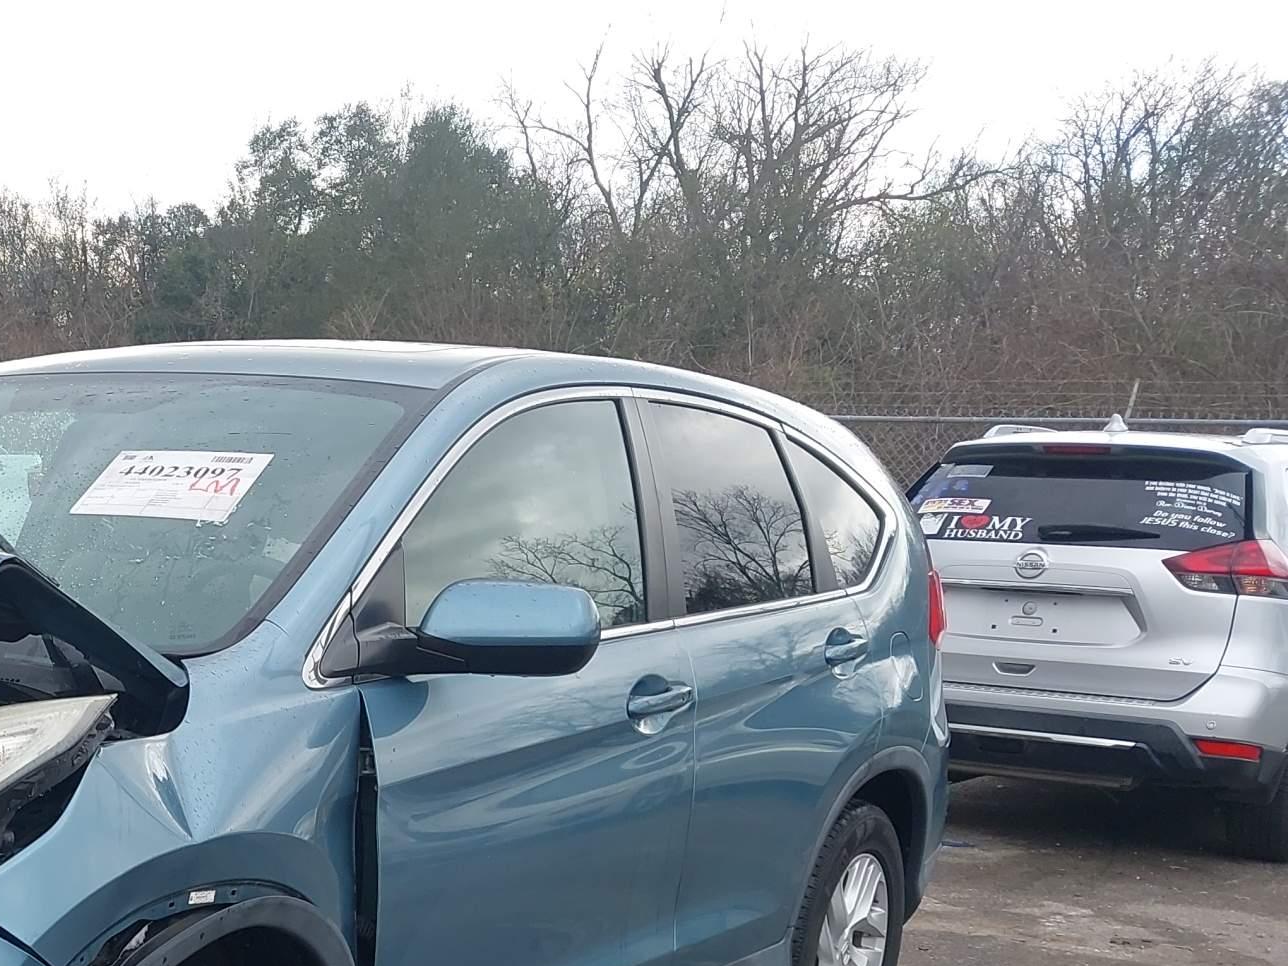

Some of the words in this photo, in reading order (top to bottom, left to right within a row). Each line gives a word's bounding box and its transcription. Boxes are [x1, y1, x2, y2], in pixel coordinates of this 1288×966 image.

[119, 464, 243, 480] 44023097
[986, 515, 1032, 531] MY
[1153, 510, 1169, 518] Do
[1193, 515, 1227, 528] follow
[943, 528, 1023, 540] HUSBAND
[1139, 517, 1179, 527] JESUS
[1178, 521, 1199, 530] this
[1200, 526, 1236, 539] close?
